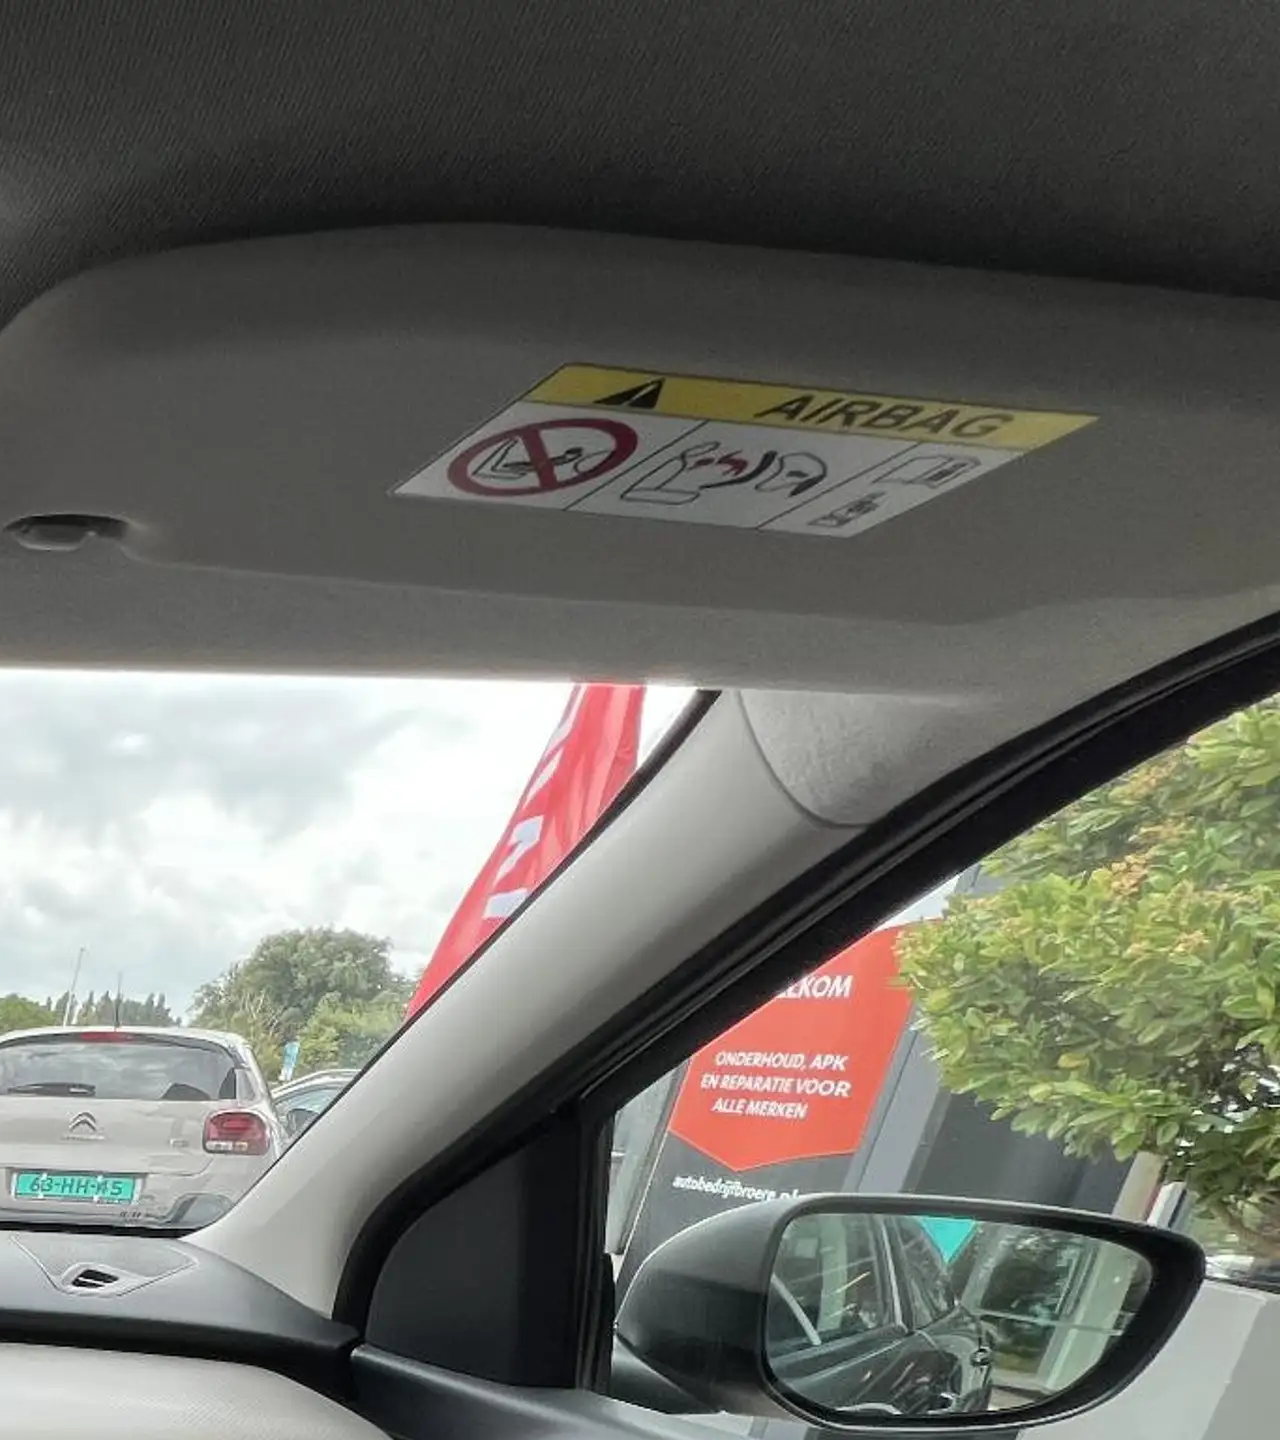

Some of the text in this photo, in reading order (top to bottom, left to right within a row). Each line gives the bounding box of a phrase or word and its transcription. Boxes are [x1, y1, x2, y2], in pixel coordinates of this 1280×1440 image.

[753, 394, 1015, 439] AIRBAG
[715, 1052, 850, 1071] ONDERHOUD, APK
[701, 1073, 851, 1097] EN REPARATIE VOOR
[711, 1098, 809, 1119] ALLE MERKEN
